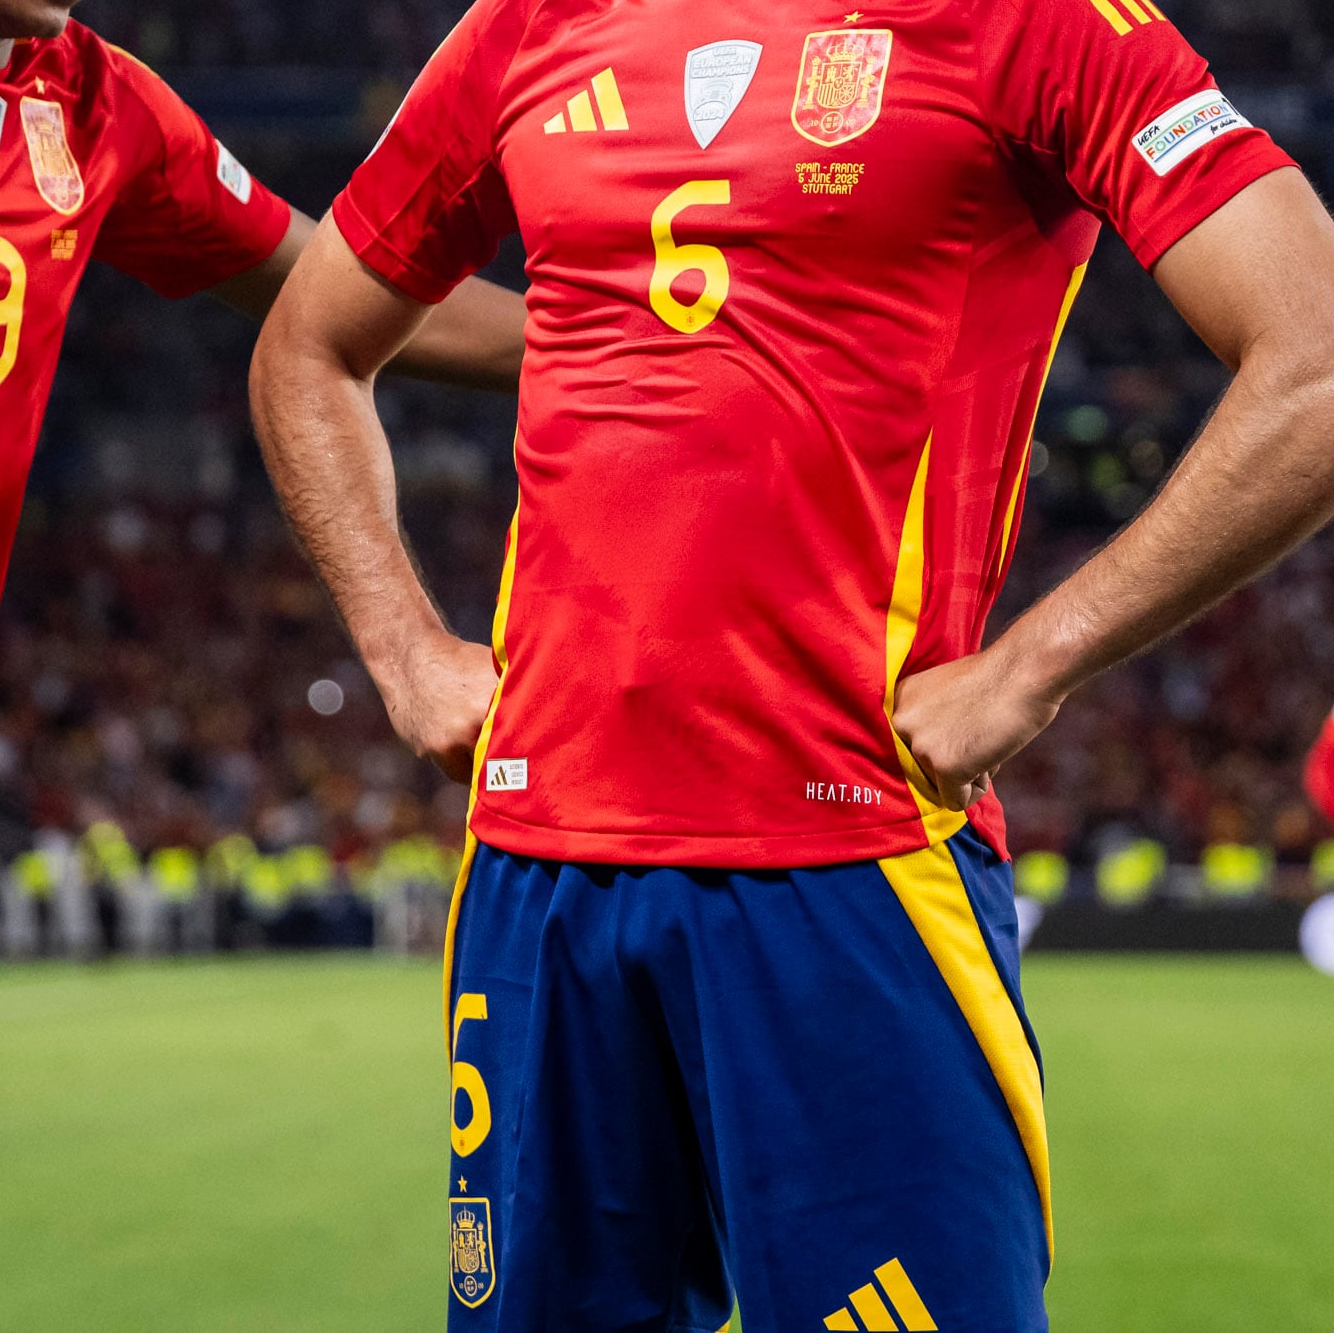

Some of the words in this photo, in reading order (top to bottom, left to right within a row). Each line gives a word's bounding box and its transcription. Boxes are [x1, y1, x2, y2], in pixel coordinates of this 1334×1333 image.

[694, 54, 752, 68] EUROPEAN
[691, 65, 749, 78] CHAMPIONS
[1137, 125, 1160, 146] UEFA
[1145, 104, 1229, 160] FOUNDATION
[795, 162, 821, 173] SPAIN
[829, 162, 865, 174] FRANCE
[798, 173, 805, 183] 5
[808, 172, 832, 183] JUNE
[834, 173, 859, 184] 2025
[802, 183, 854, 195] STUTTGART
[649, 179, 731, 335] 6
[806, 781, 882, 806] HEAT.RDY
[450, 992, 492, 1158] 6
